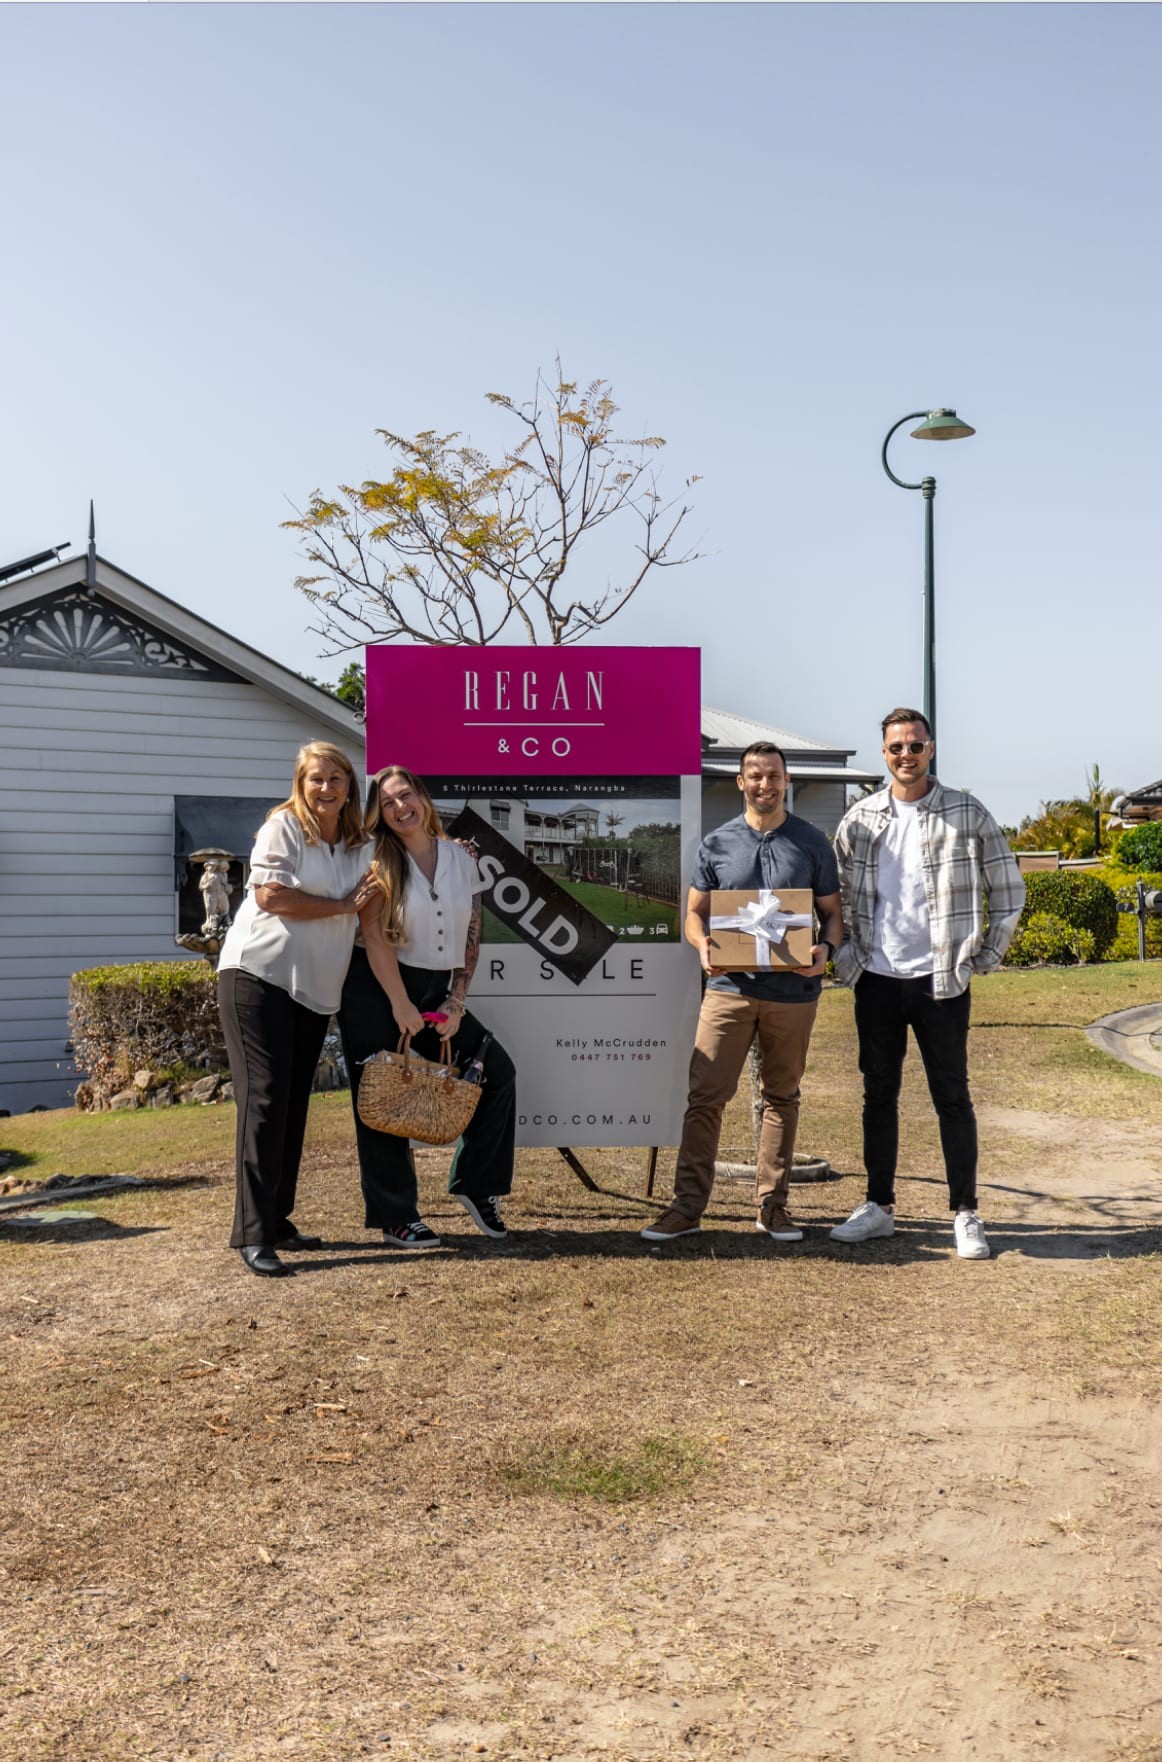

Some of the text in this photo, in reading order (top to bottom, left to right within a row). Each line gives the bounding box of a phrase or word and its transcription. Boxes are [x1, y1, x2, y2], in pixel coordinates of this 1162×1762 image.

[464, 671, 605, 710] REGAN
[498, 737, 571, 757] & CO
[574, 784, 625, 793] Narangba
[472, 855, 579, 955] SOLD
[619, 927, 655, 935] 2 3
[540, 959, 644, 980] SLE
[556, 1038, 667, 1049] Kelly McCrudden
[571, 1053, 600, 1061] 0447
[518, 1114, 651, 1126] DCO.COM.AU
